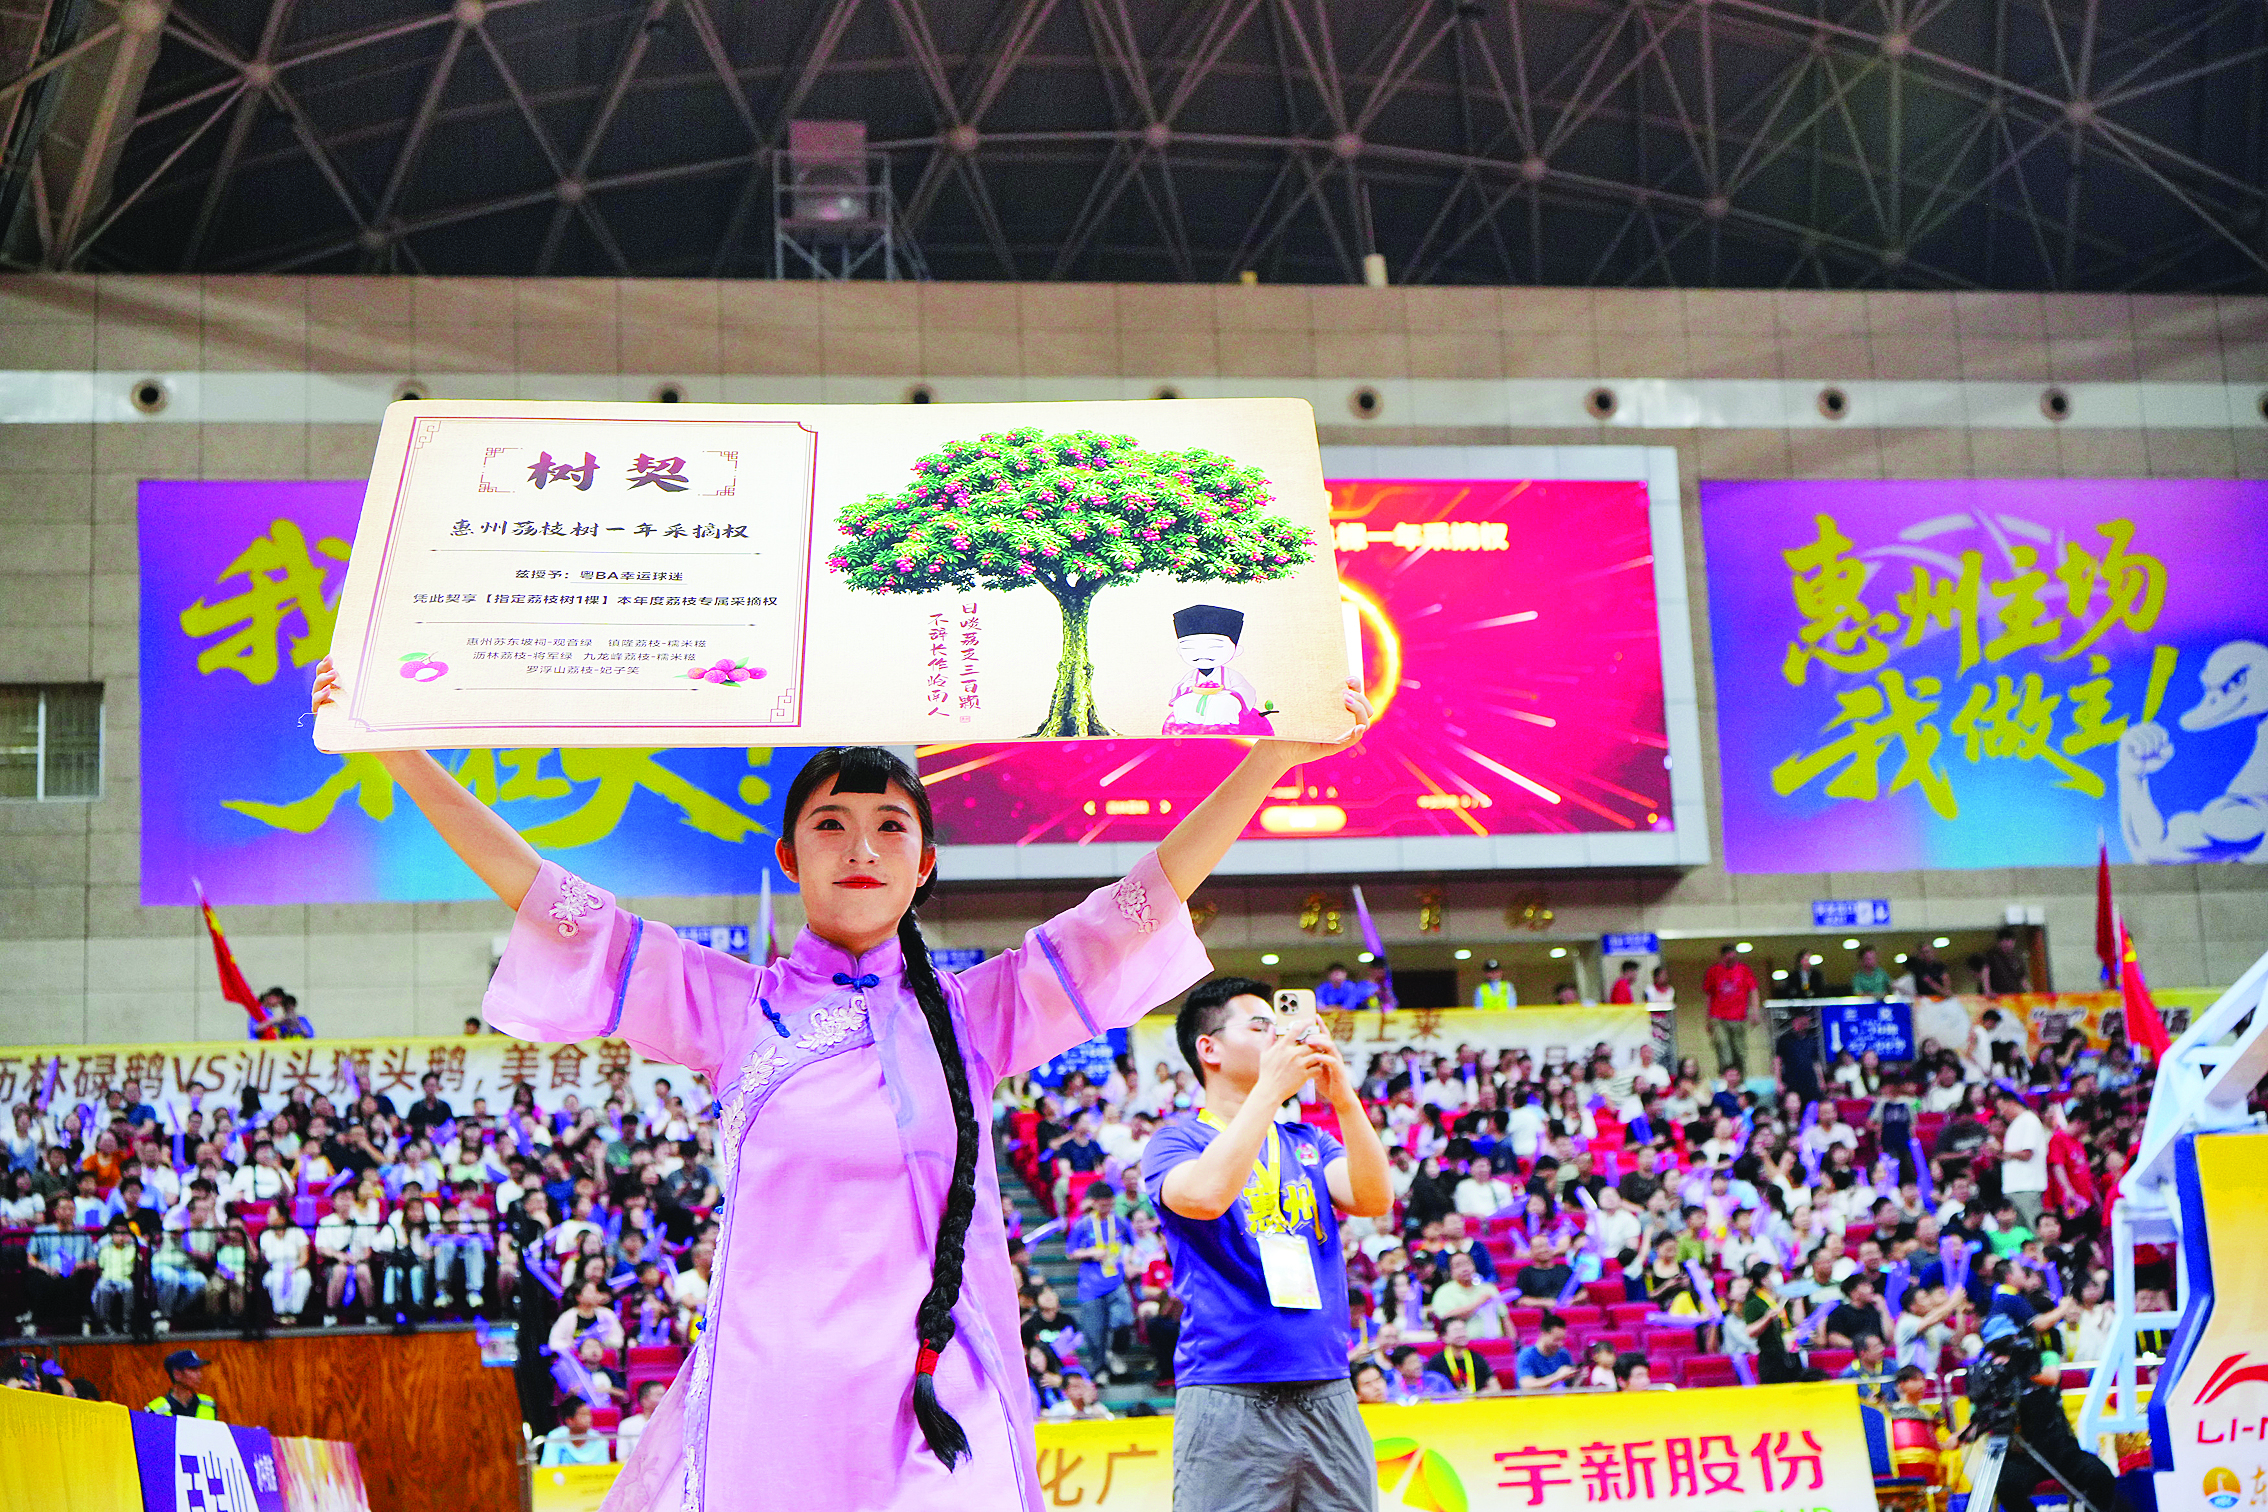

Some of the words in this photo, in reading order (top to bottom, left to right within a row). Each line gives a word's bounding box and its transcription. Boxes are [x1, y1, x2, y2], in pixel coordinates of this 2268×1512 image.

[527, 451, 690, 492] 树契
[450, 519, 749, 538] 惠州荔枝树一年采摘权
[1782, 514, 2168, 686] 惠州主场
[526, 665, 640, 675] 罗浮山荔枝-妃子笑
[927, 613, 950, 717] 不辞长作岭南人
[1242, 1175, 1326, 1242] 惠州
[1493, 1430, 1825, 1506] 宇新股份
